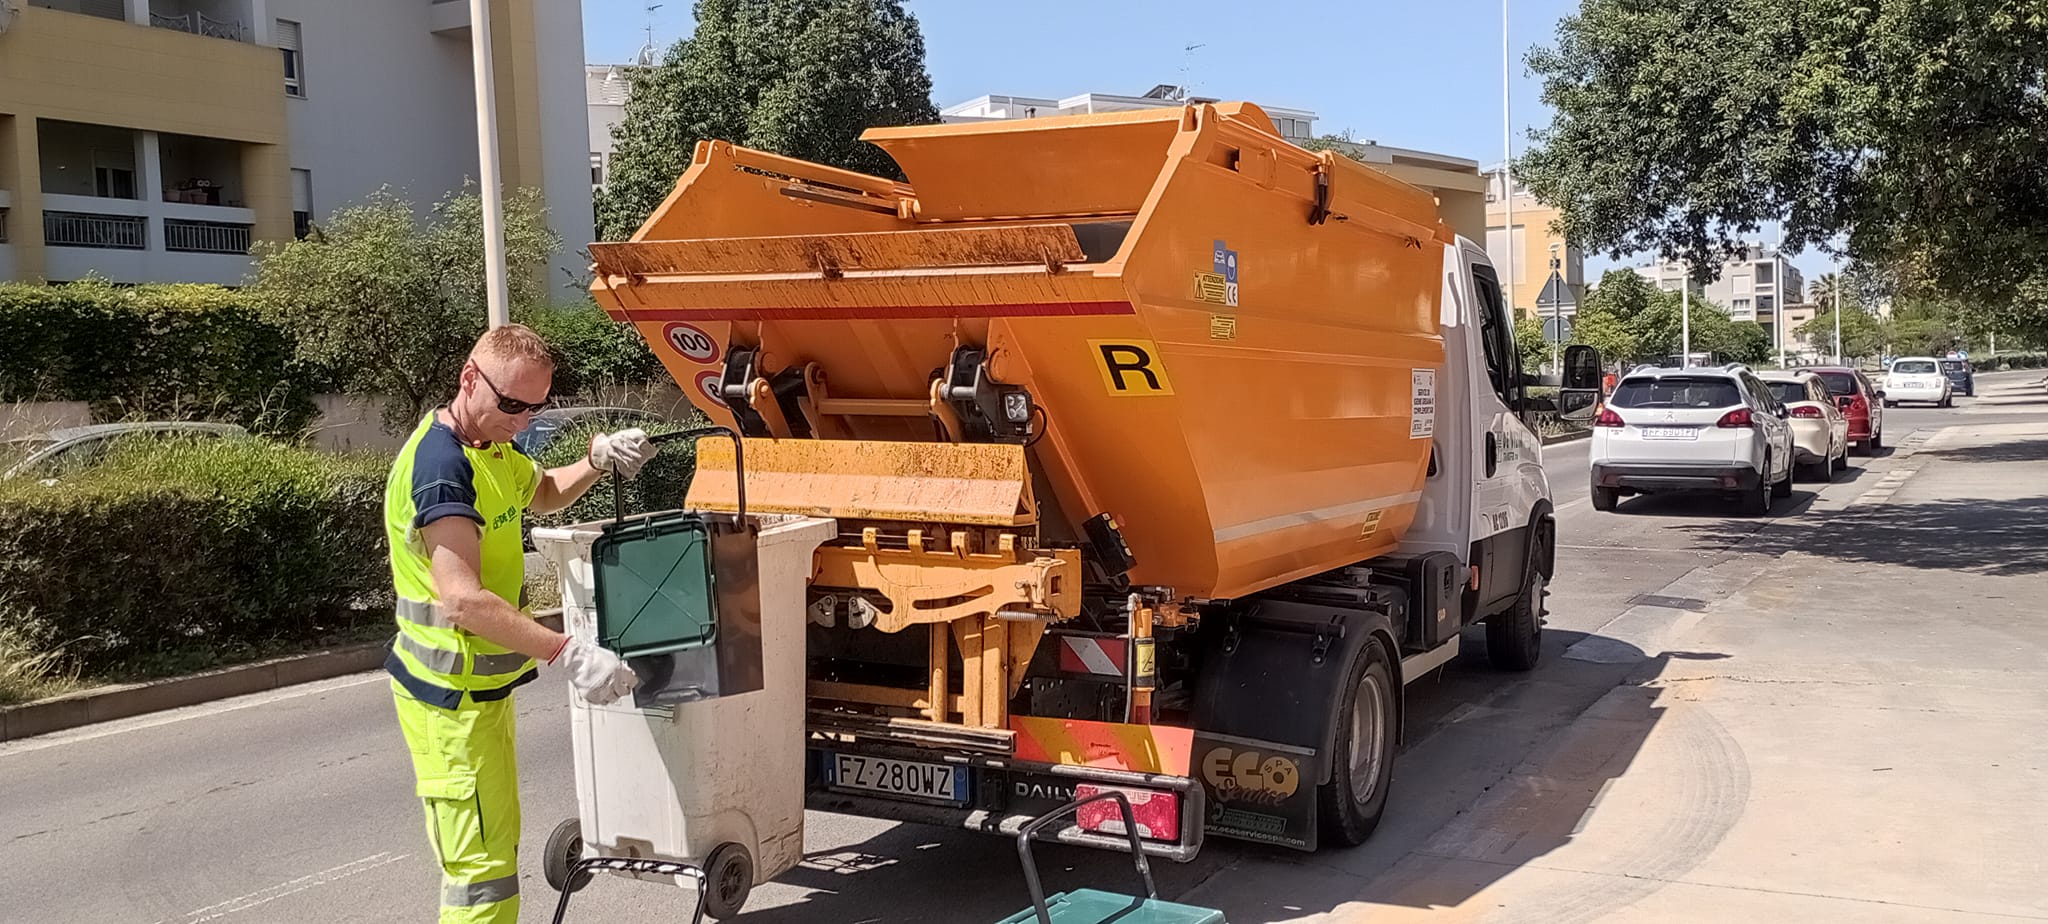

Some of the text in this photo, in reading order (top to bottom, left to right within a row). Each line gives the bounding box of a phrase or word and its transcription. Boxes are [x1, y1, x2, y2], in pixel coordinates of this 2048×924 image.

[672, 333, 710, 351] 100
[1099, 344, 1162, 390] R
[1203, 747, 1299, 799] ECO
